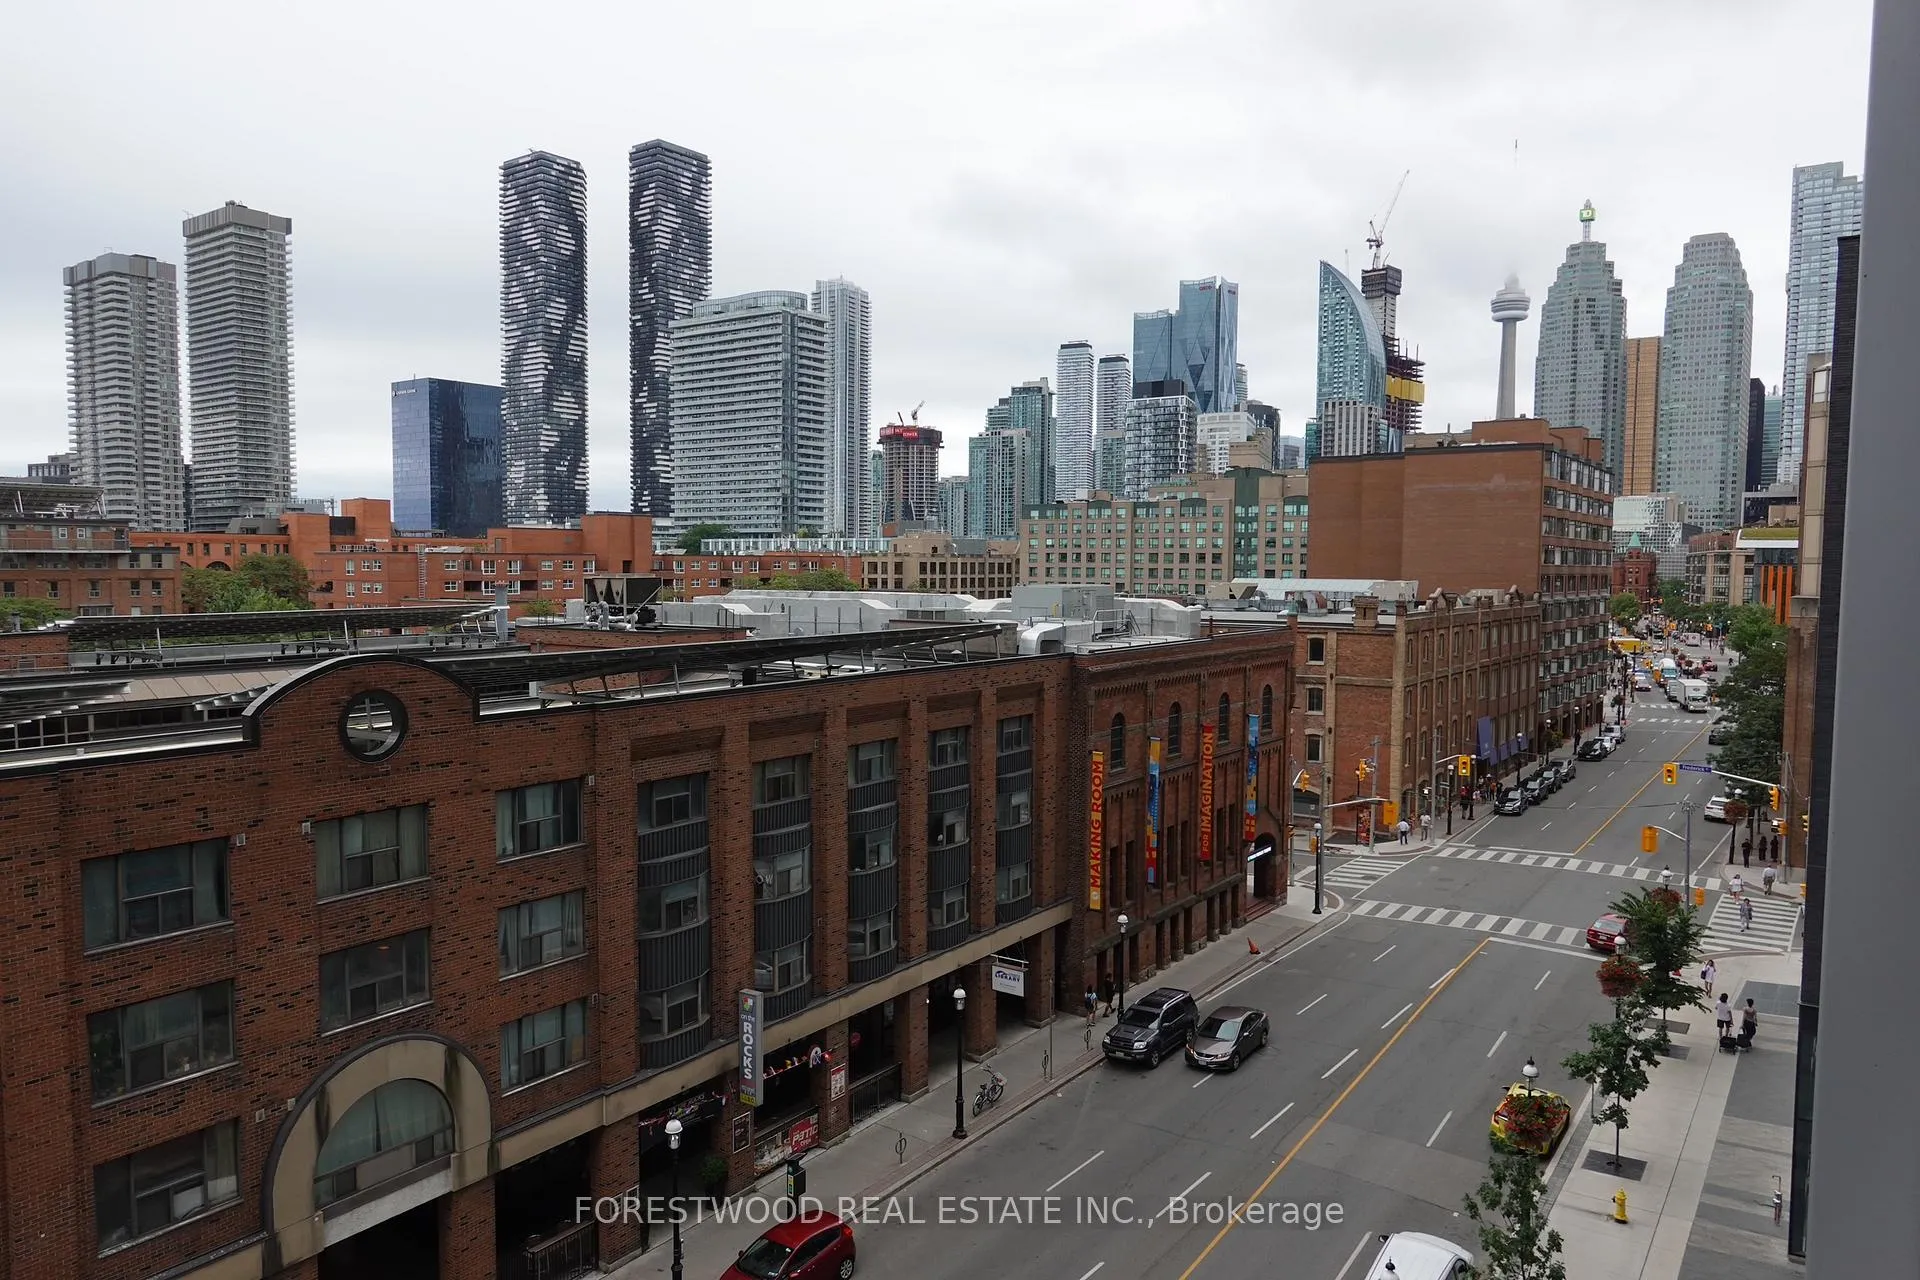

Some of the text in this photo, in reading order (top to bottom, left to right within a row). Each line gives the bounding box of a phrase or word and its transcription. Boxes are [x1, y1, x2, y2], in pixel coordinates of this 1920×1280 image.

[1200, 732, 1213, 830] IMAGINATION
[1089, 759, 1104, 889] MAKING ROOM
[995, 972, 1020, 983] LIBRARY
[742, 1021, 754, 1080] ROCKS
